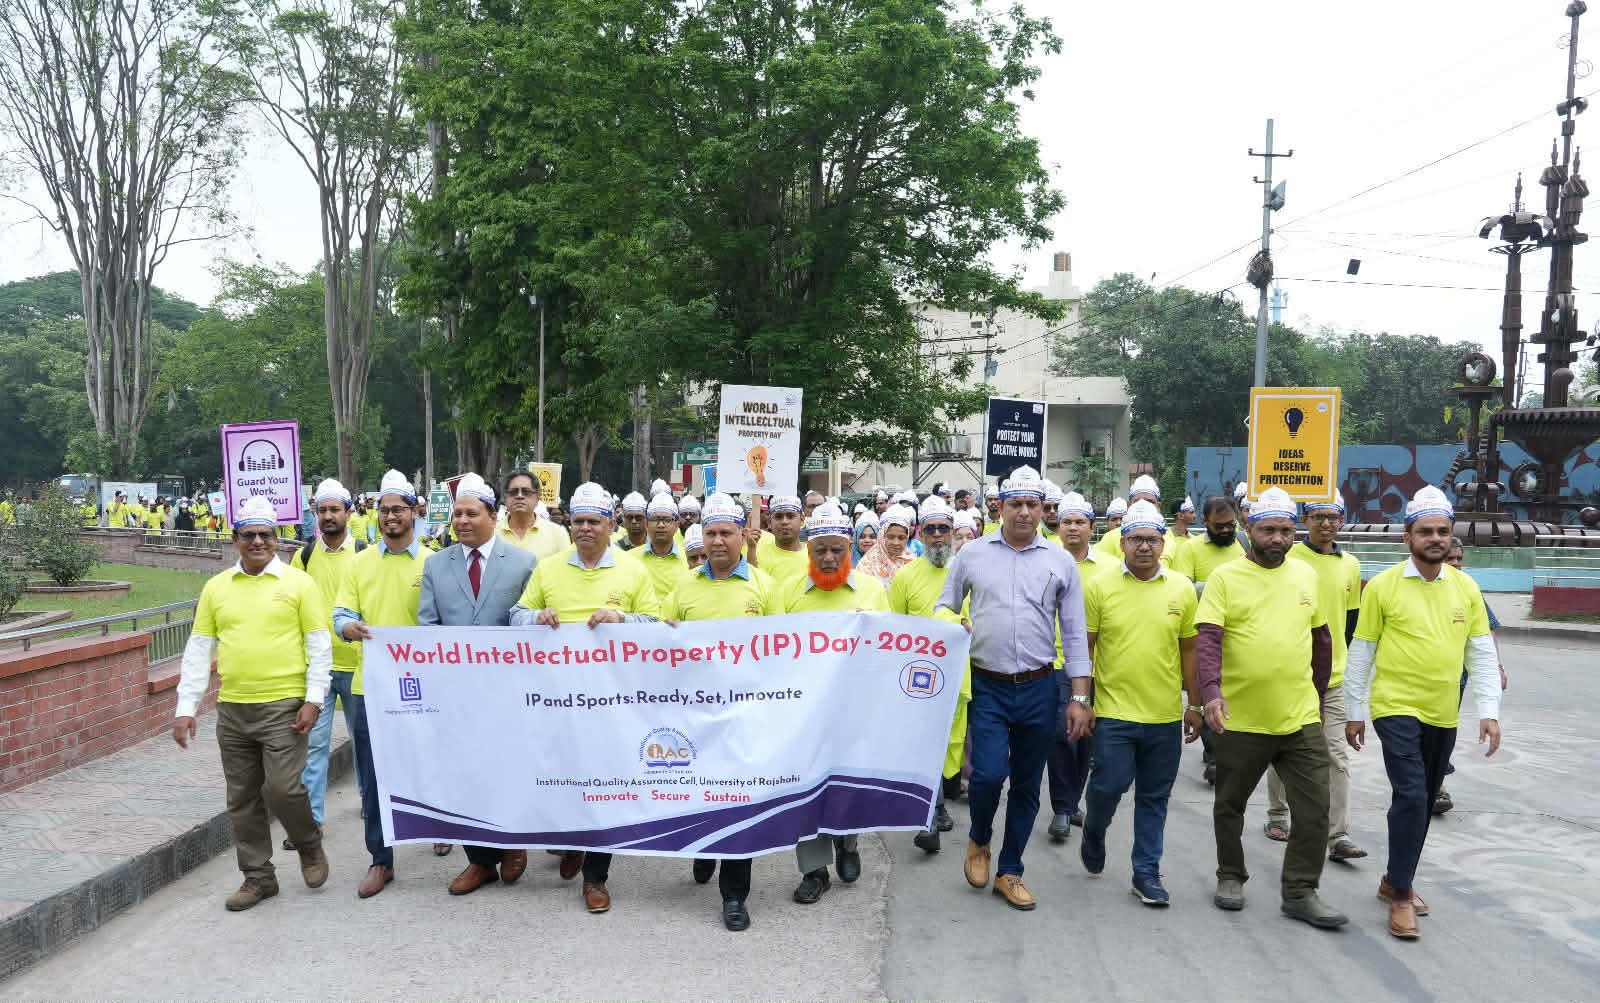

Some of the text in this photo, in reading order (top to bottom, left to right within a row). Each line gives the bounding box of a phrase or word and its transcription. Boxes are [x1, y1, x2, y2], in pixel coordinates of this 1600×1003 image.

[743, 401, 778, 414] WORLD
[738, 430, 768, 439] PROPERTY
[996, 429, 1035, 443] PROTECT YOUR
[992, 443, 1038, 458] CREATIVE WORKS
[1279, 449, 1304, 459] IDEAS
[1273, 461, 1311, 472] DESERVE
[237, 476, 288, 487] Guard Your
[386, 642, 462, 664] World
[466, 639, 616, 665] Intellectual
[622, 640, 744, 667] Property
[750, 632, 802, 661] (IP)
[808, 631, 861, 656] Day
[877, 631, 947, 658] 2026
[526, 692, 541, 707] IP
[543, 693, 573, 707] and
[576, 693, 634, 710] Sports:
[695, 690, 726, 705] Set,
[729, 688, 803, 704] Innovate
[536, 774, 801, 788] Institutional Quality Assurance Cell, University of Rajshahi
[583, 790, 752, 802] Innovate Secure Sustain
